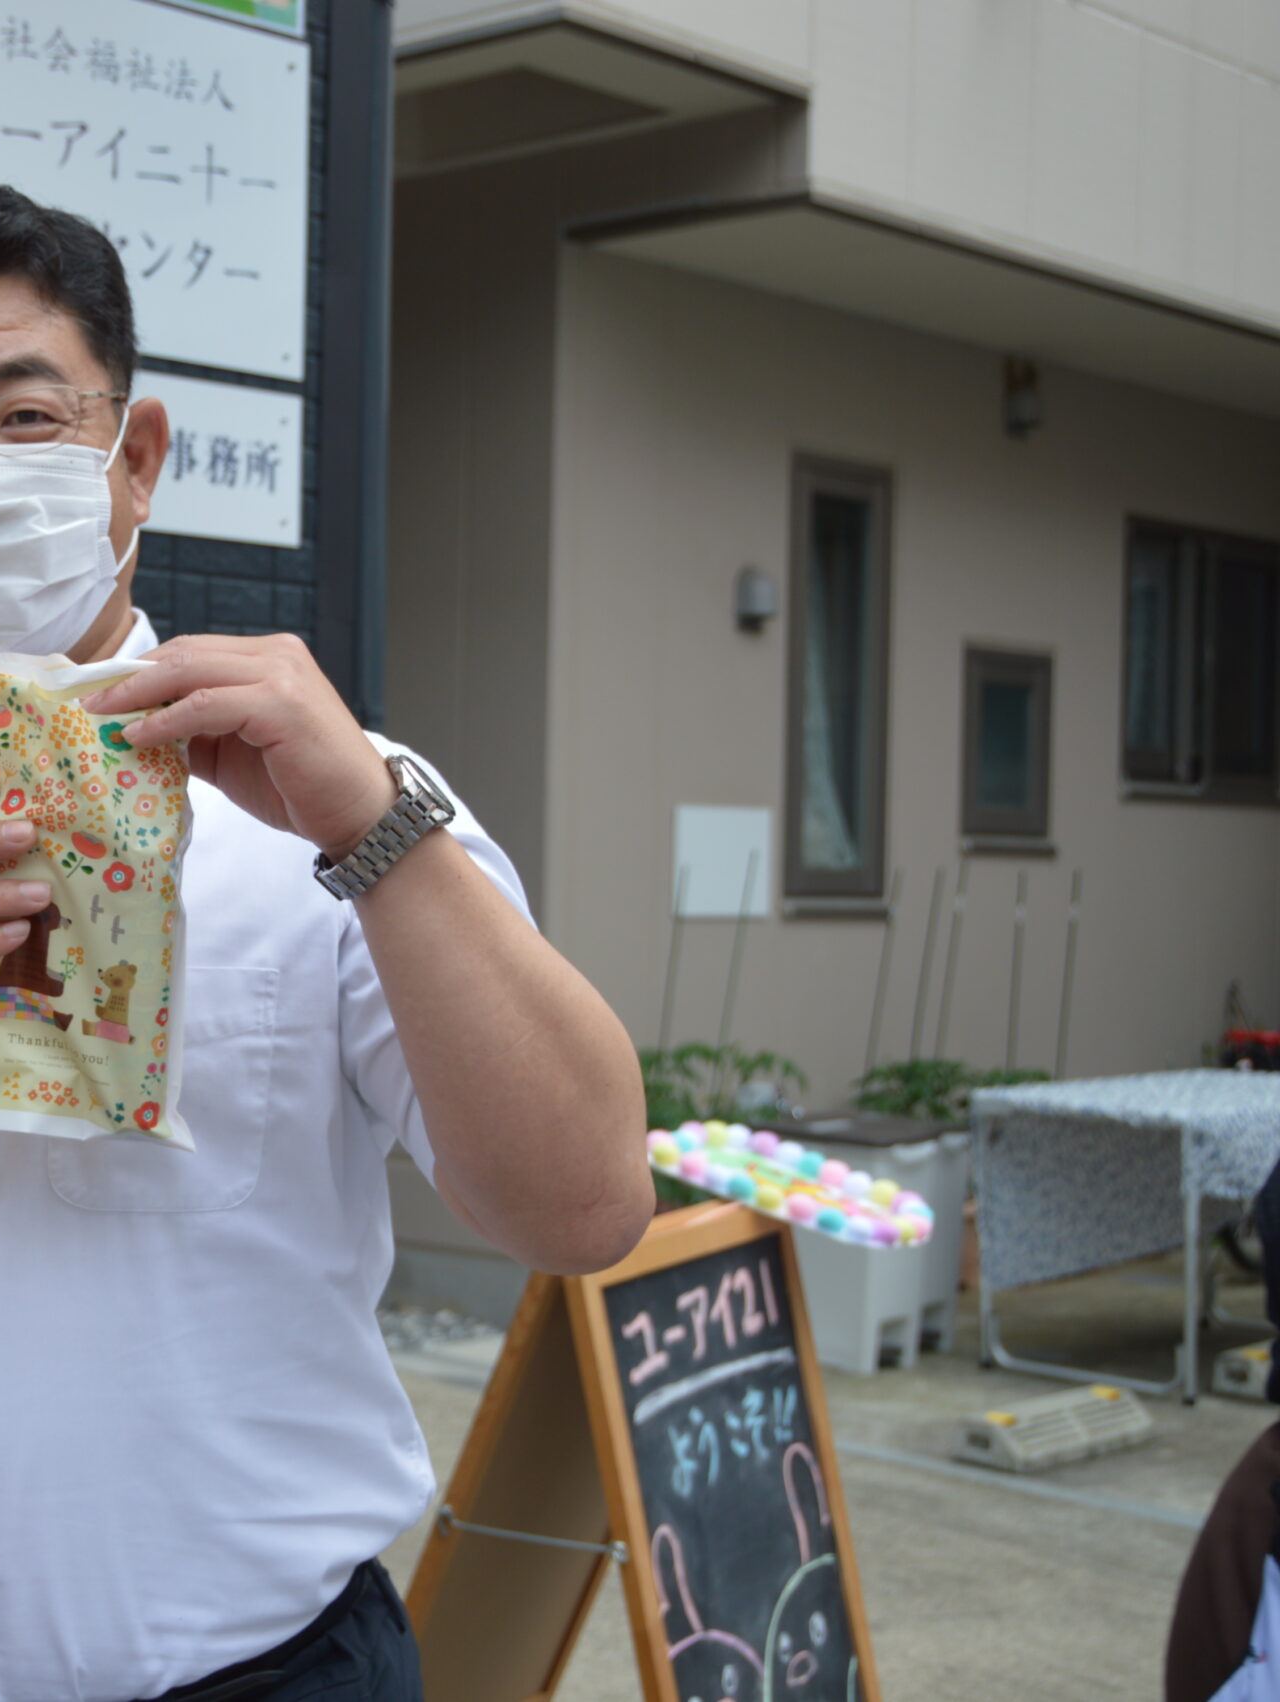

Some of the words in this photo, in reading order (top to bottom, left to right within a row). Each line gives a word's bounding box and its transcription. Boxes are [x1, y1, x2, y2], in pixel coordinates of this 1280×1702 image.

[0, 15, 235, 112] 社会福祉法人
[168, 428, 281, 494] 事務所
[81, 1053, 110, 1067] you!
[621, 1258, 780, 1386] ユーアイ21
